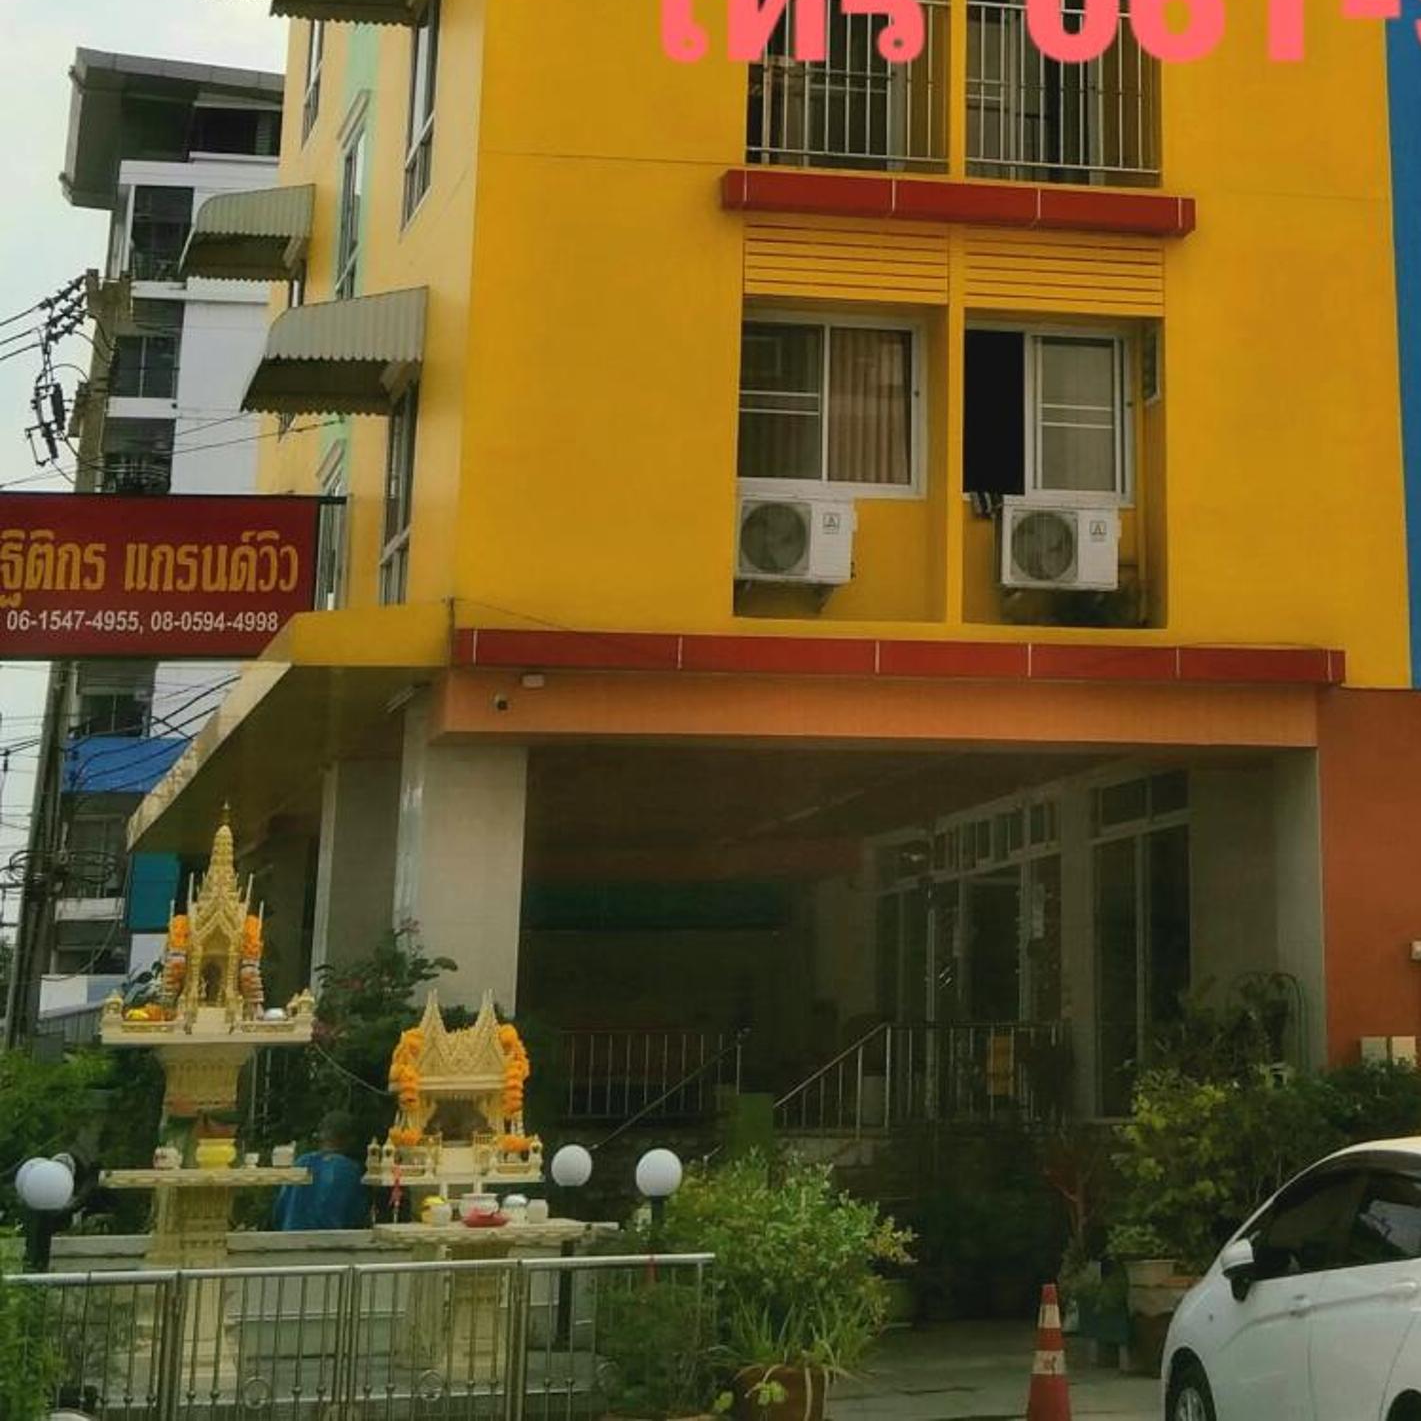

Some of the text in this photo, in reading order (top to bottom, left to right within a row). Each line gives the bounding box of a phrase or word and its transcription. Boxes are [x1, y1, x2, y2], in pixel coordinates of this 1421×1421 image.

[124, 530, 298, 592] แกรนด์วิว
[6, 609, 279, 634] 06-1547-4955, 08-0594-4998
